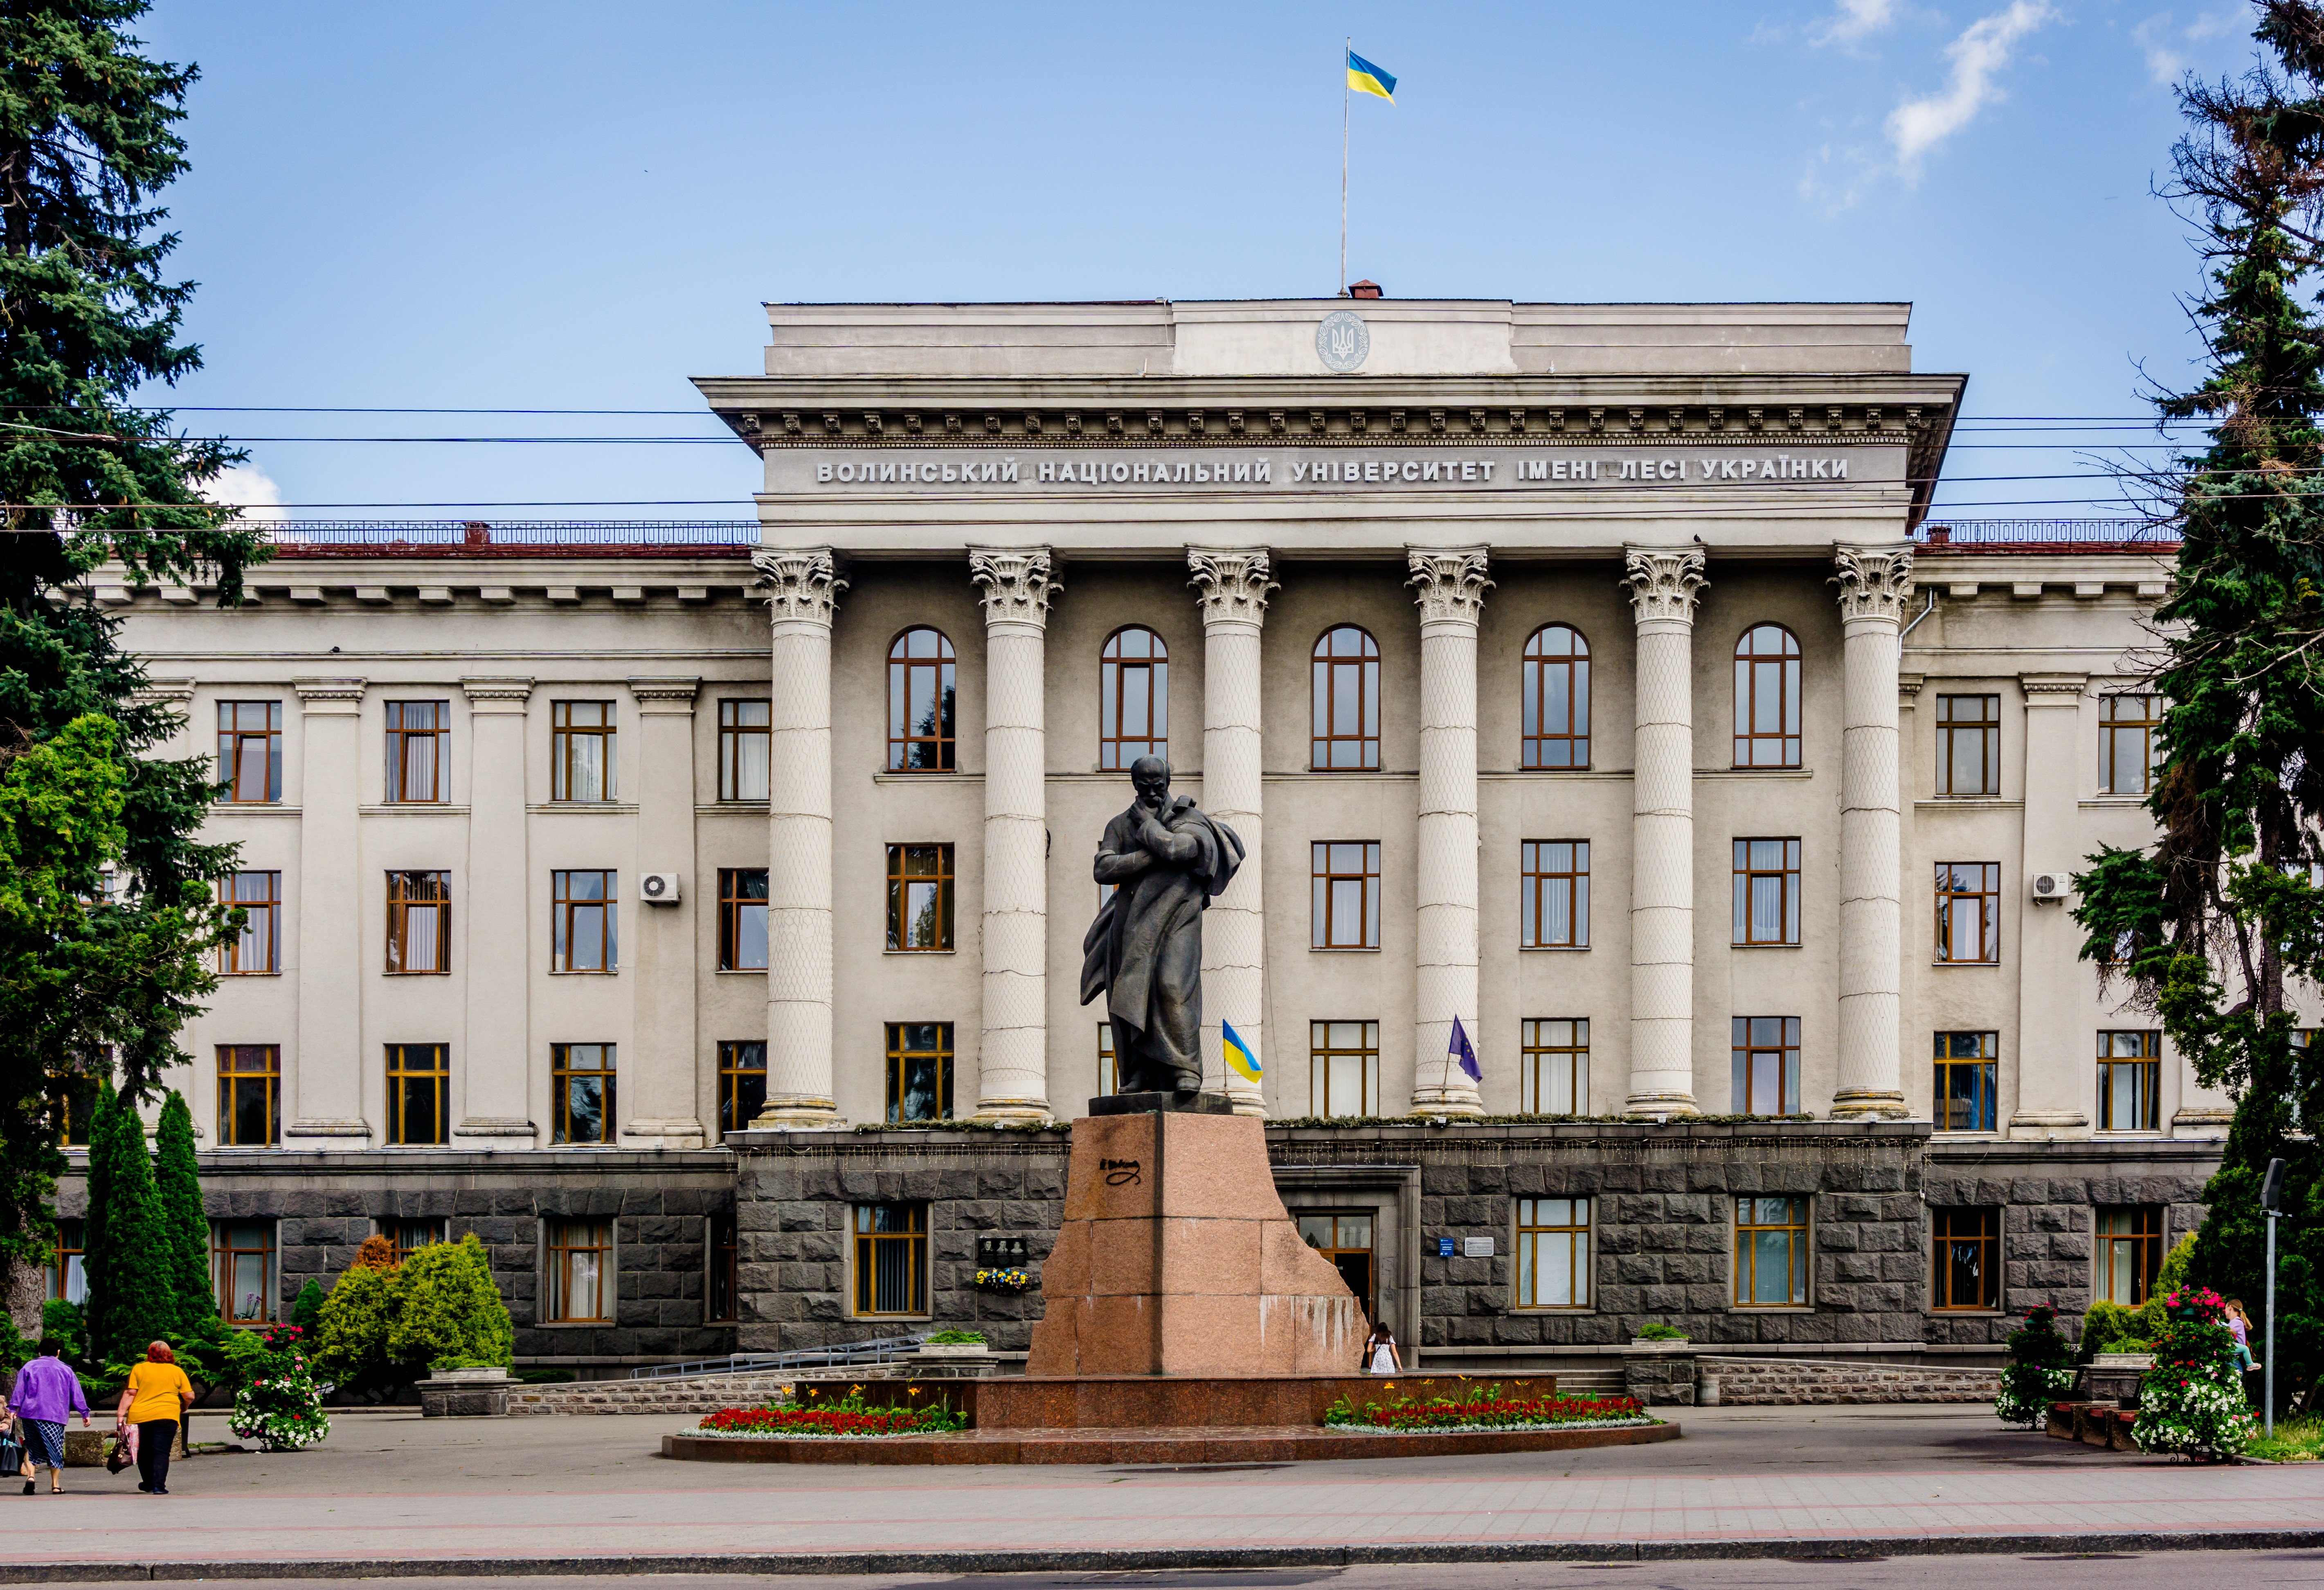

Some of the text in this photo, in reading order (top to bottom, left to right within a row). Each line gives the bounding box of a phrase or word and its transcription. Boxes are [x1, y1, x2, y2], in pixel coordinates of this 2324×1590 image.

[817, 455, 1847, 485] ВОЛИНСЬКИЙ НАЦІОНАЛЬНИЙ УНІВЕРСИТЕТ ІМЕНІ ЛЕСІ УКРАЇНКИ
